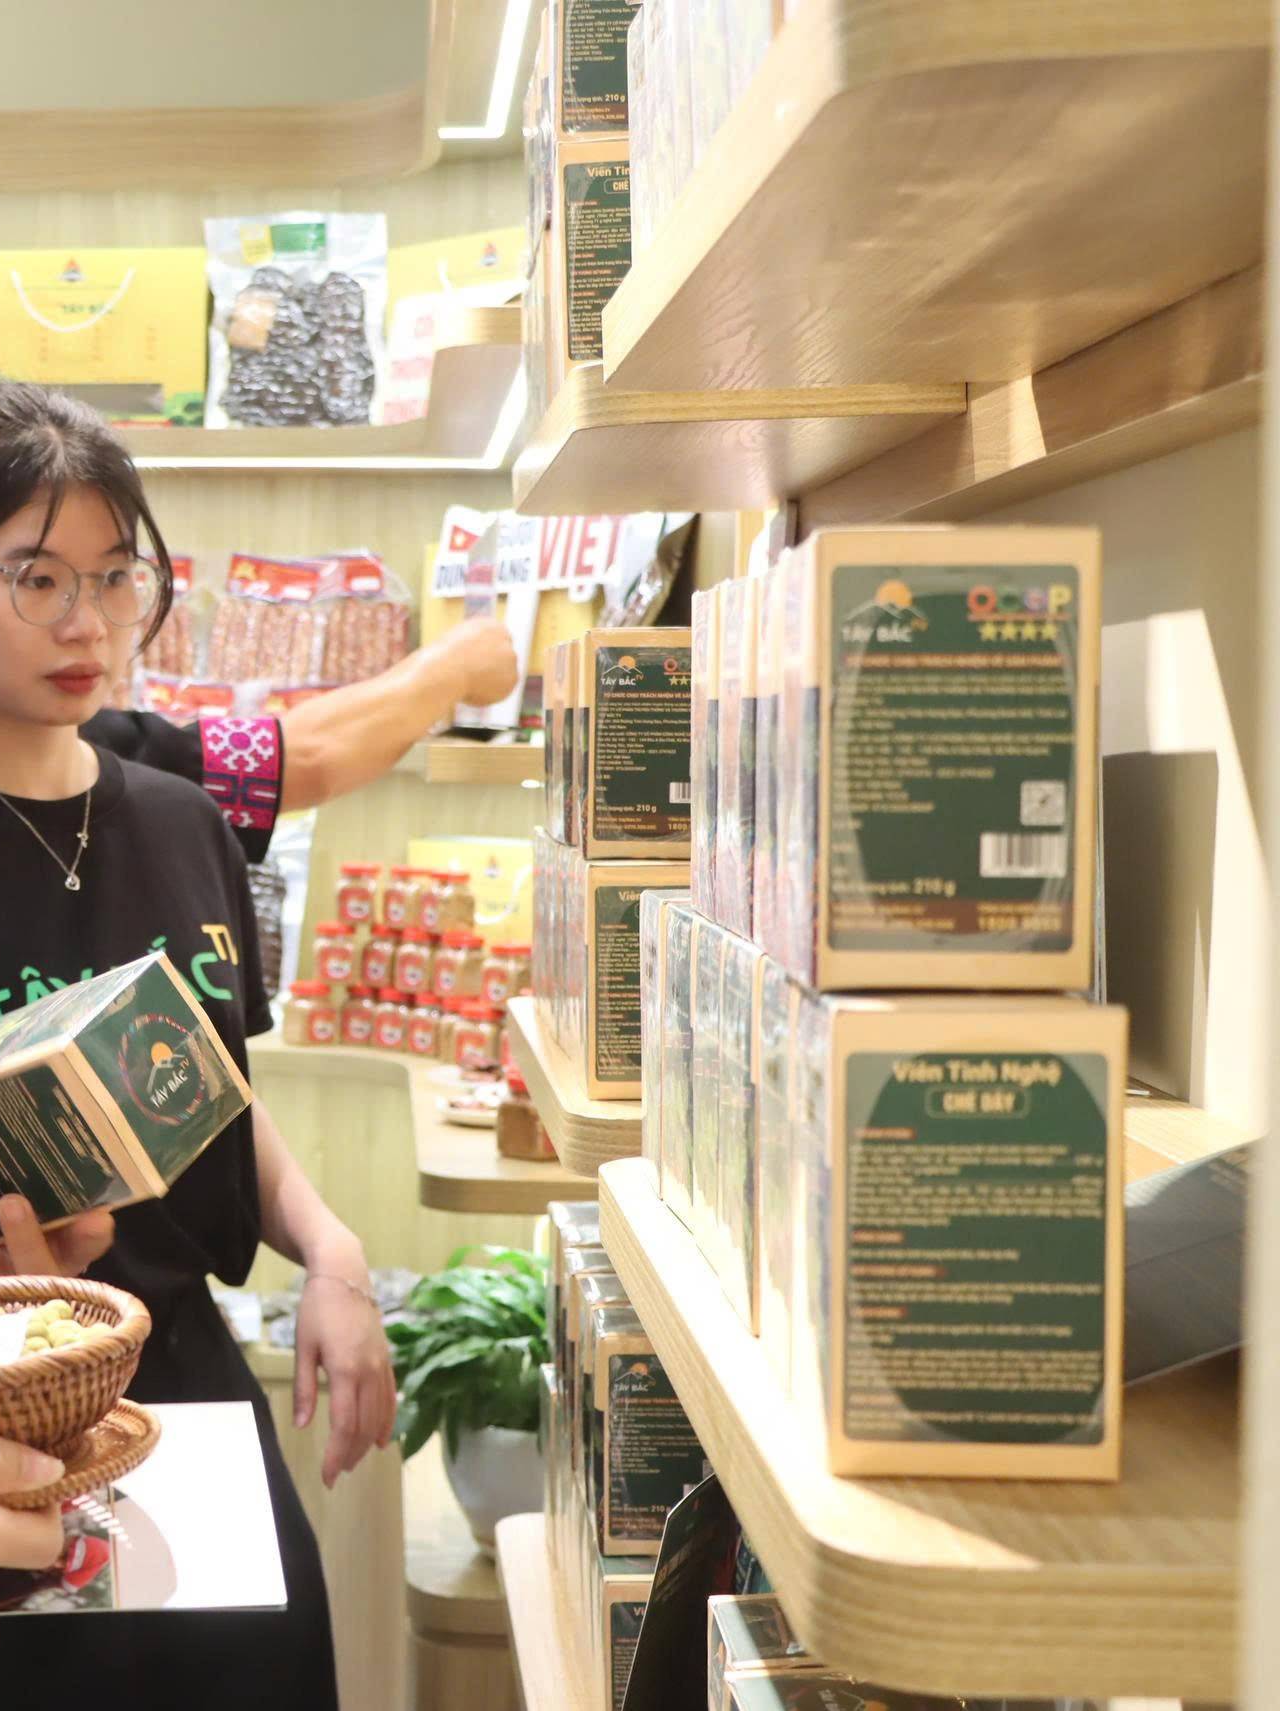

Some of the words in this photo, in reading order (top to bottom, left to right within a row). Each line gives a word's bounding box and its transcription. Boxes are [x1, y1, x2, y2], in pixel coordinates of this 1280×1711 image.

[605, 94, 619, 102] 210
[600, 676, 617, 686] TÂY
[618, 676, 636, 686] BẮC
[636, 804, 650, 812] 210
